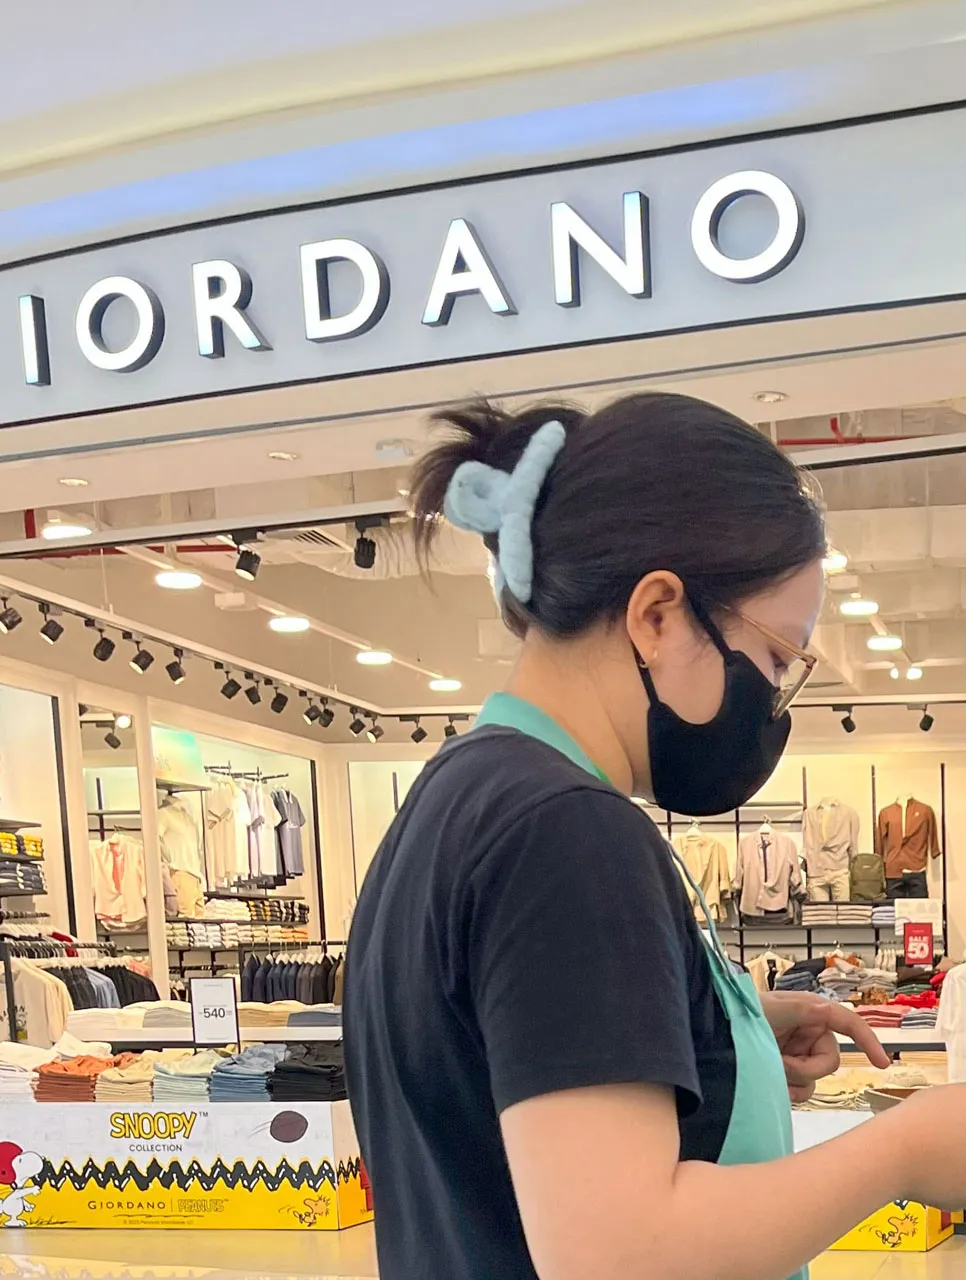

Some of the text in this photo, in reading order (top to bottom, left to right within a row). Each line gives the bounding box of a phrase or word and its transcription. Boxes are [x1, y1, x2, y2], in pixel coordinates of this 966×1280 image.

[18, 169, 805, 387] IORDANO
[203, 1008, 226, 1019] 540
[110, 1111, 197, 1140] SNOOPY
[129, 1144, 183, 1152] COLLECTION
[88, 1199, 225, 1212] GIORDANO PEANUTS
